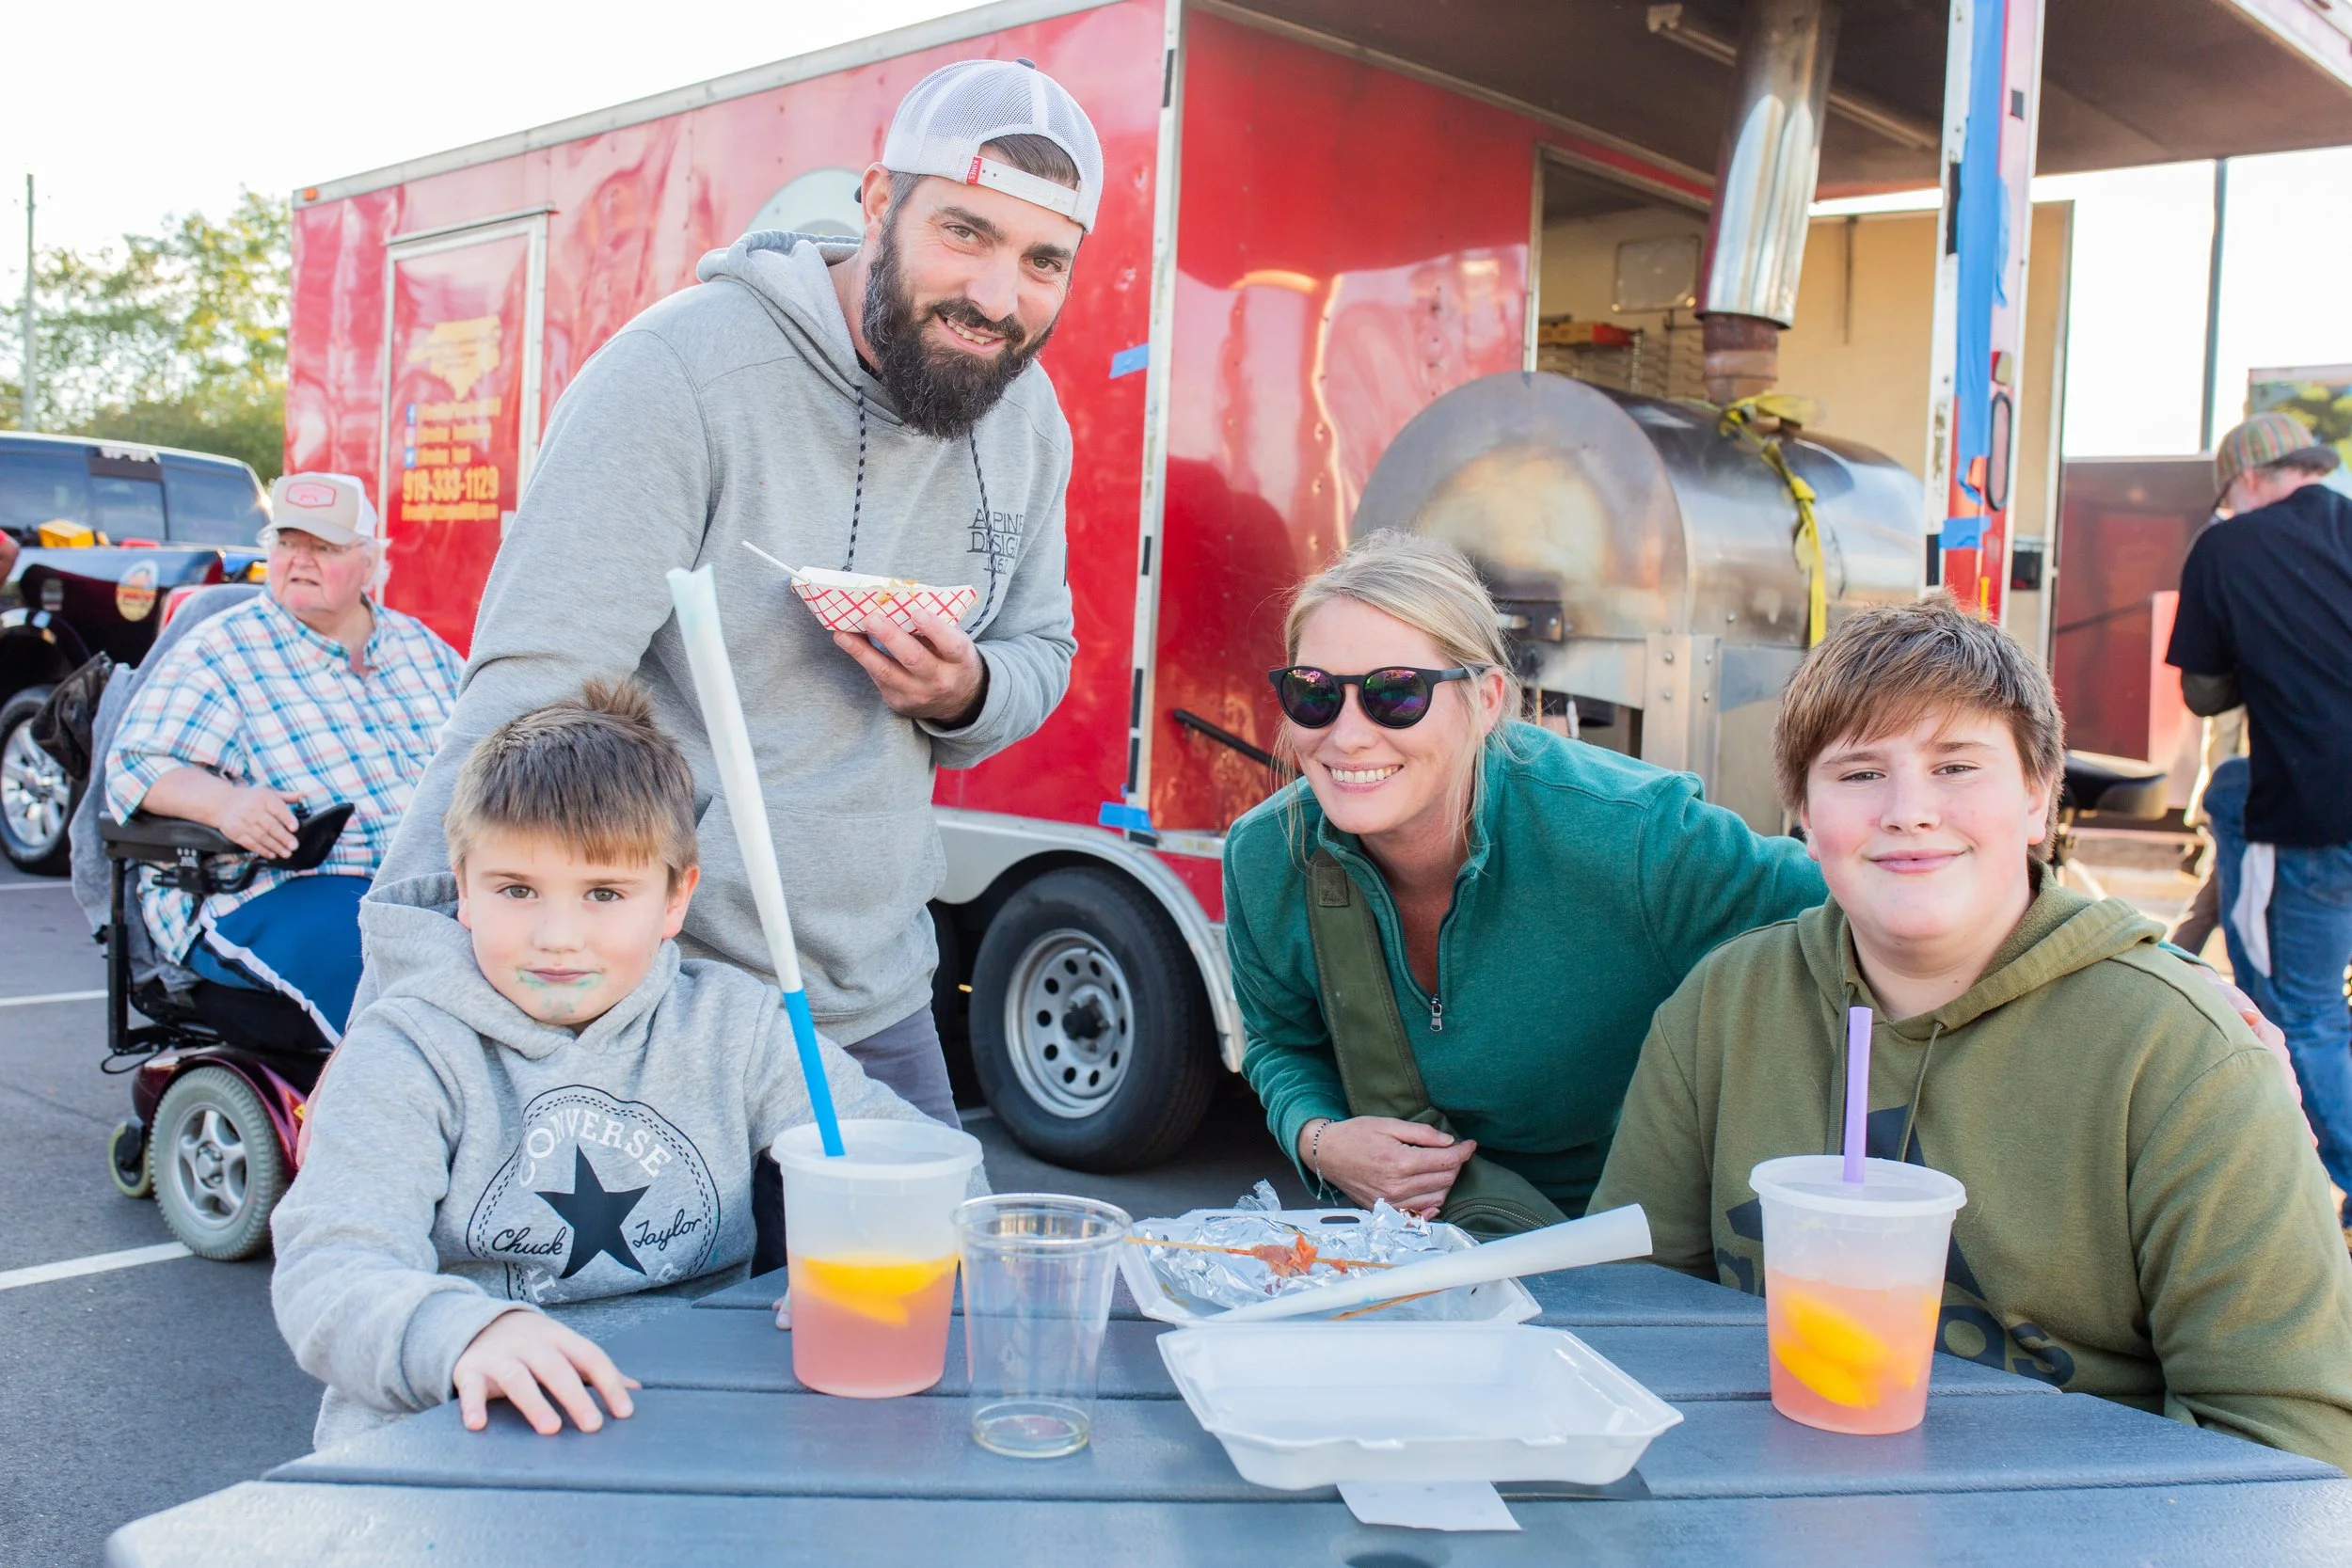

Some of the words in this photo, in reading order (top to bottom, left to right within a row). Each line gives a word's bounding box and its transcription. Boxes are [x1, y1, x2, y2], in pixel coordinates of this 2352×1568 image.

[969, 160, 979, 180] KIMES
[967, 508, 1024, 536] APINE
[967, 531, 1019, 559] DSIG
[519, 1108, 672, 1186] CONVERSE
[492, 1227, 566, 1255] Chuck
[633, 1209, 701, 1250] Taylor
